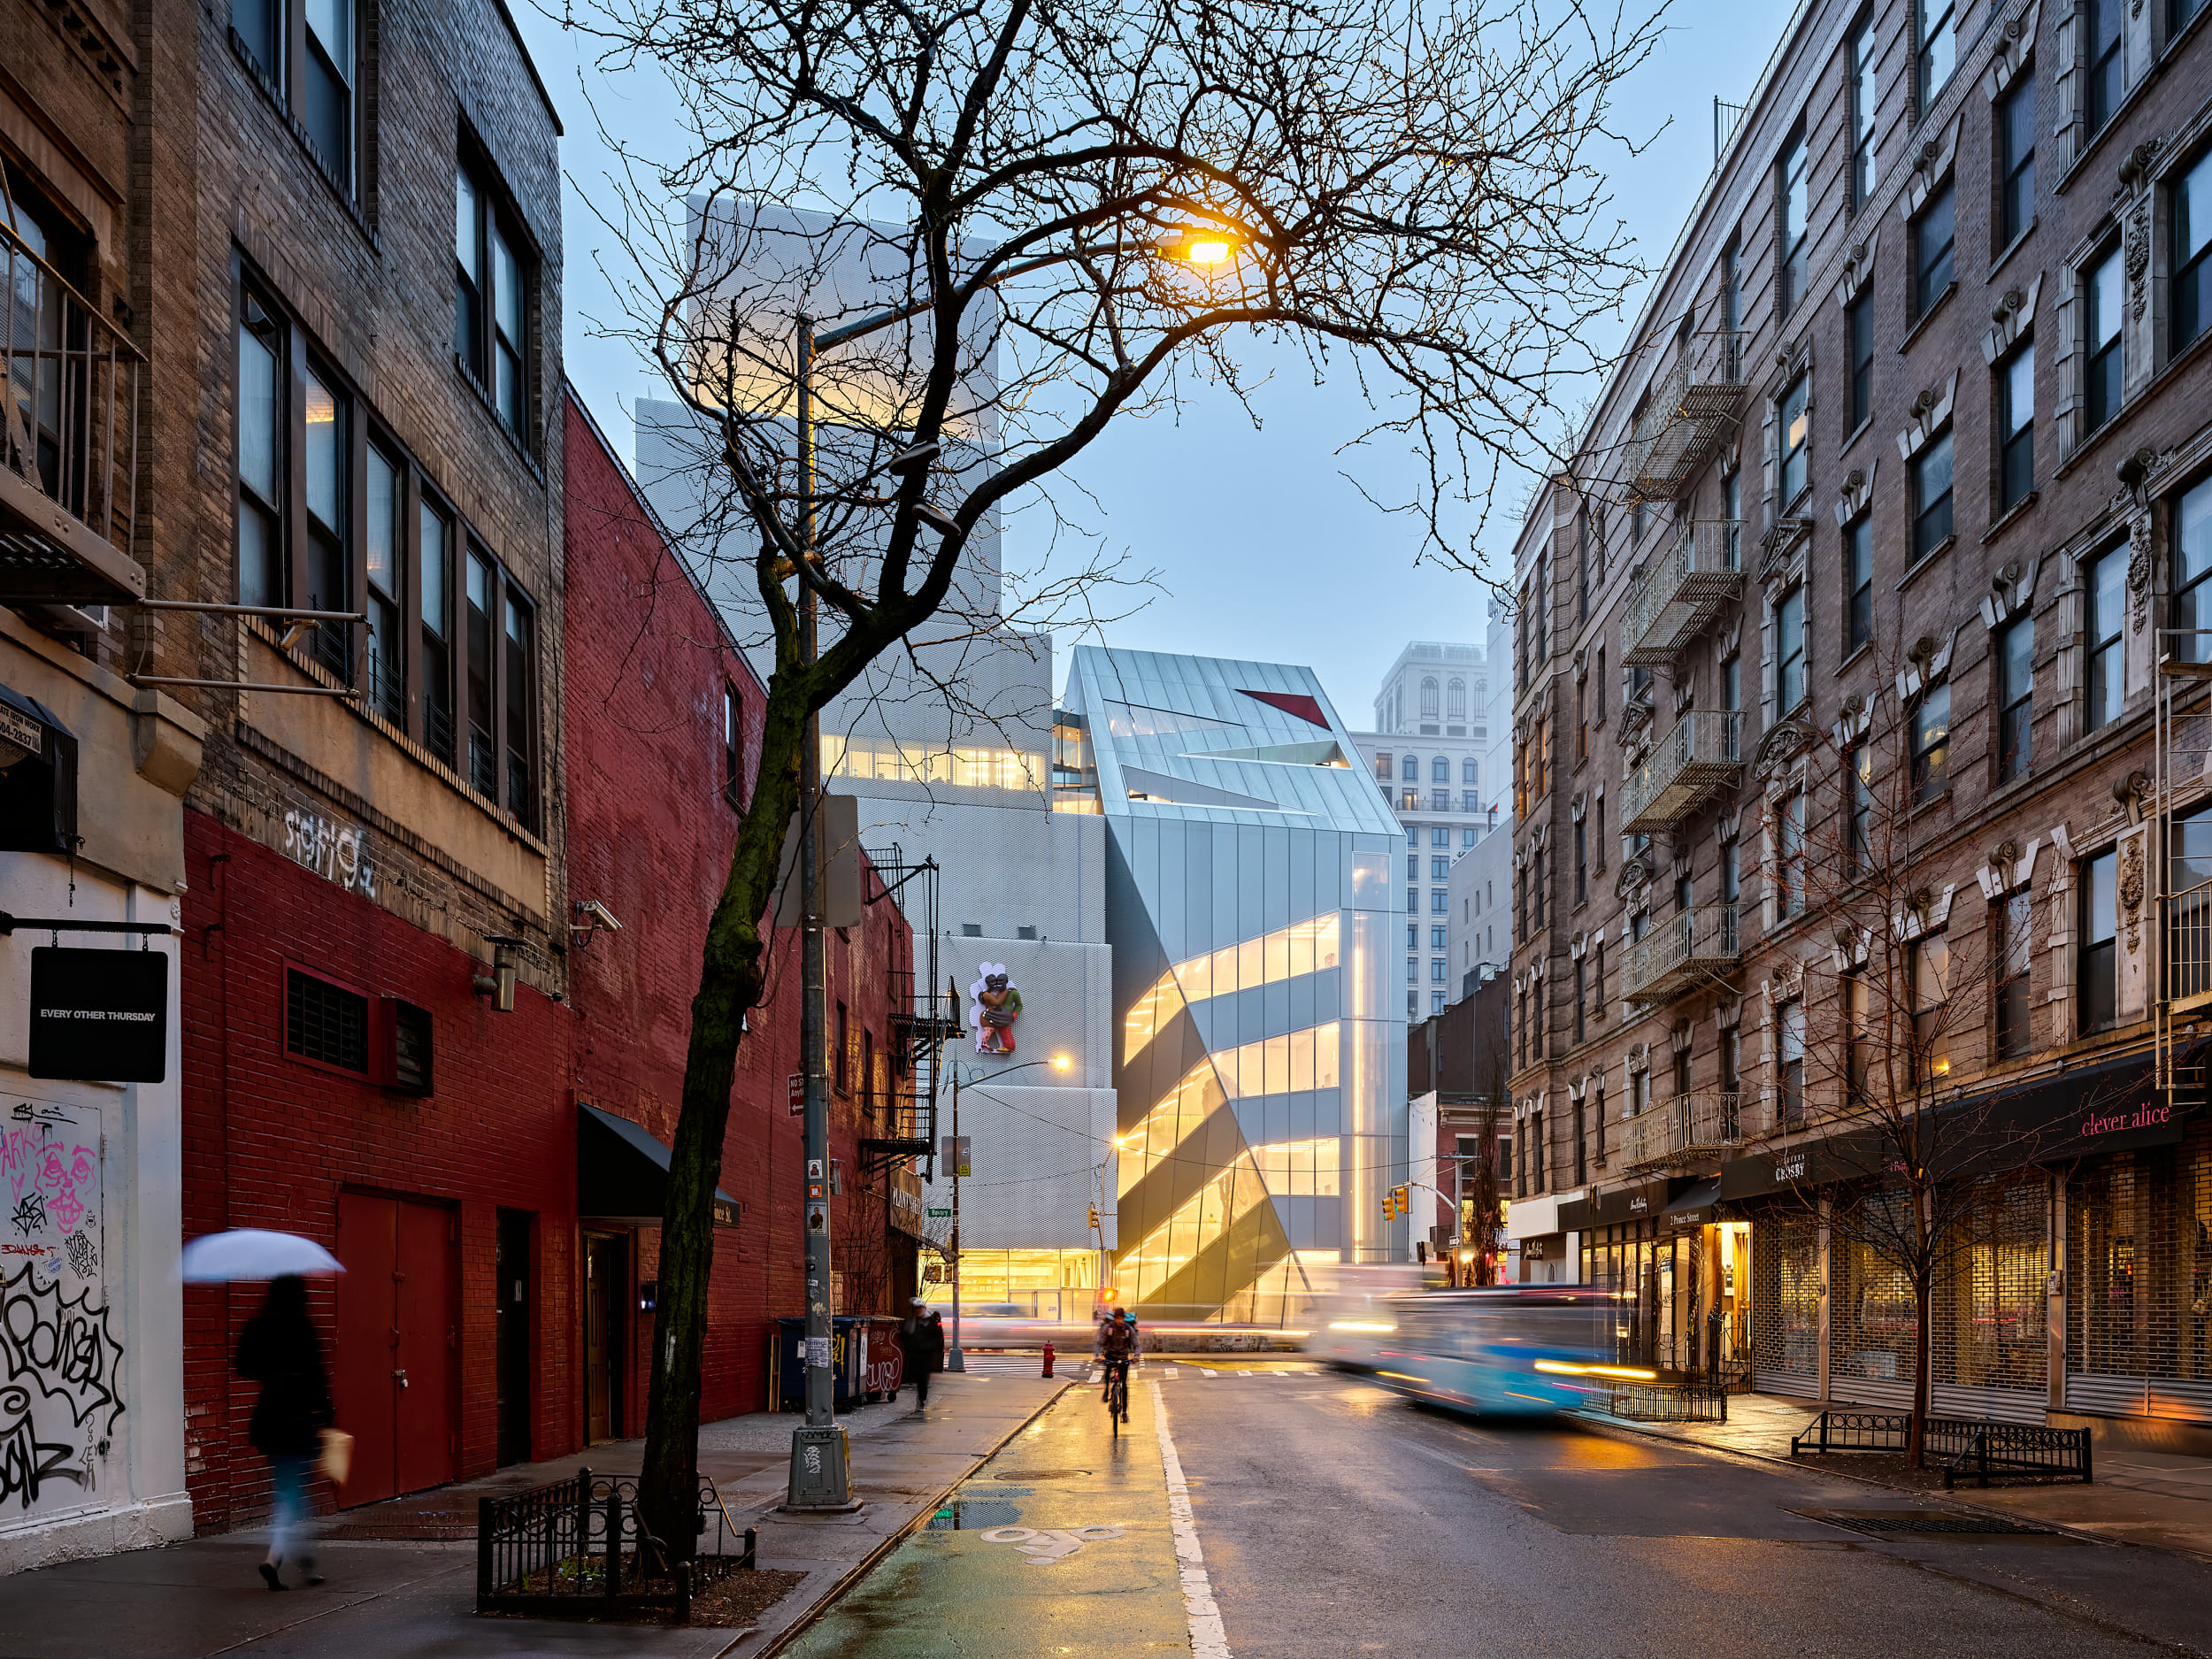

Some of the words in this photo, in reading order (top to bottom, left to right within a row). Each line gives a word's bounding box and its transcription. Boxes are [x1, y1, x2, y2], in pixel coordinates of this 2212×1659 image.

[10, 710, 24, 724] IRON
[24, 718, 41, 733] WORK
[41, 1009, 72, 1018] EVERY
[73, 1010, 105, 1019] OTHER
[107, 1011, 156, 1022] THURSDAY
[790, 1079, 798, 1088] NO
[790, 1087, 804, 1098] Anyti
[2081, 1112, 2127, 1136] clever
[2131, 1102, 2170, 1128] alice
[1775, 1162, 1805, 1183] CROSBY
[892, 1187, 910, 1211] PLANT
[714, 1203, 725, 1220] ince
[1673, 1215, 1686, 1225] Prince
[1686, 1212, 1700, 1223] Street
